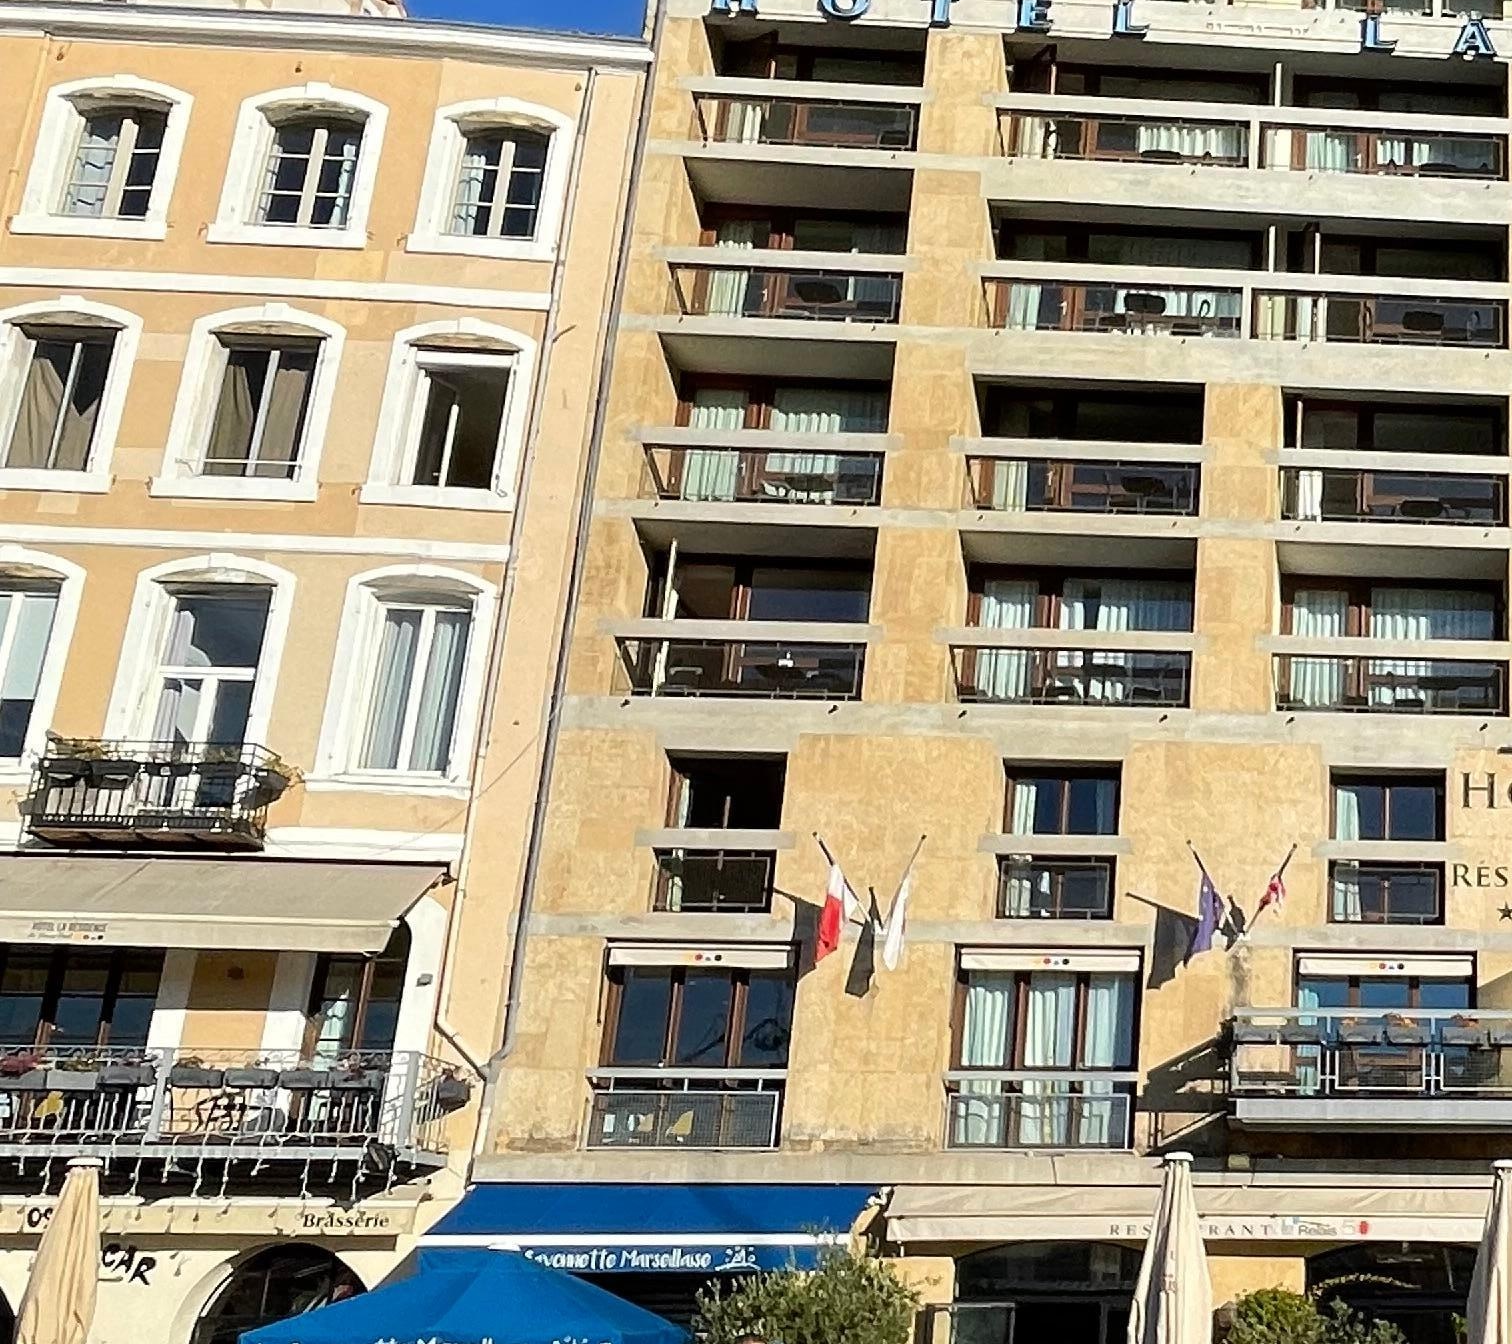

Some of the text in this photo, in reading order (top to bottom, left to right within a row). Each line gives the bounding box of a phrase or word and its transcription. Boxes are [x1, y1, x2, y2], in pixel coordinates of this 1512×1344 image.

[1361, 11, 1499, 59] LA
[303, 1212, 390, 1229] Brasserie
[1109, 1223, 1271, 1236] RESRANT
